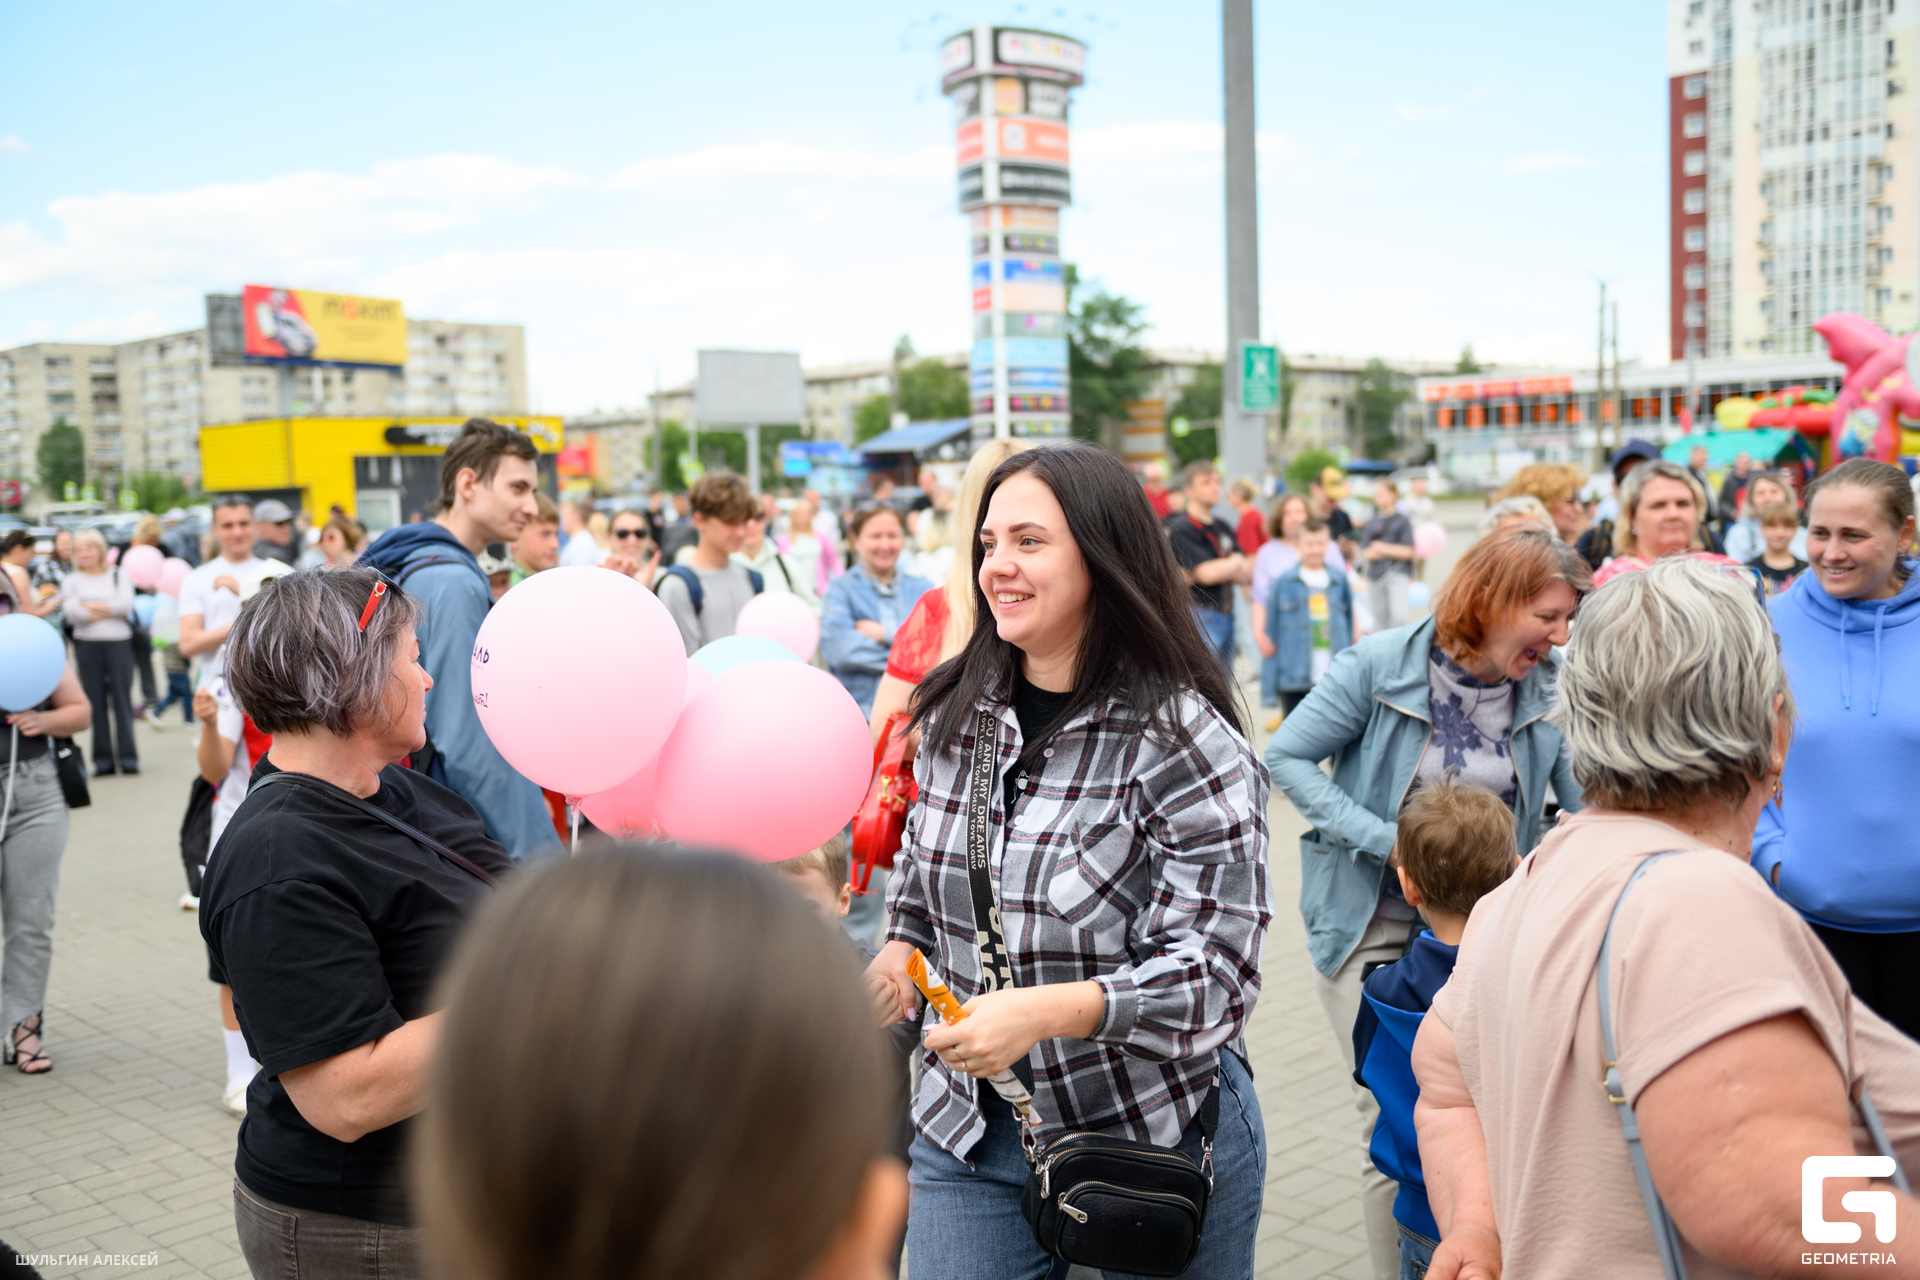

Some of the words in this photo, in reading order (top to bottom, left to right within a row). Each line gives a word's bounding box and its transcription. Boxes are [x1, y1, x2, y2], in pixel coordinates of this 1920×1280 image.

[986, 713, 995, 737] OU
[982, 743, 992, 773] AND
[979, 778, 989, 800] MY
[976, 805, 986, 869] DREAMS
